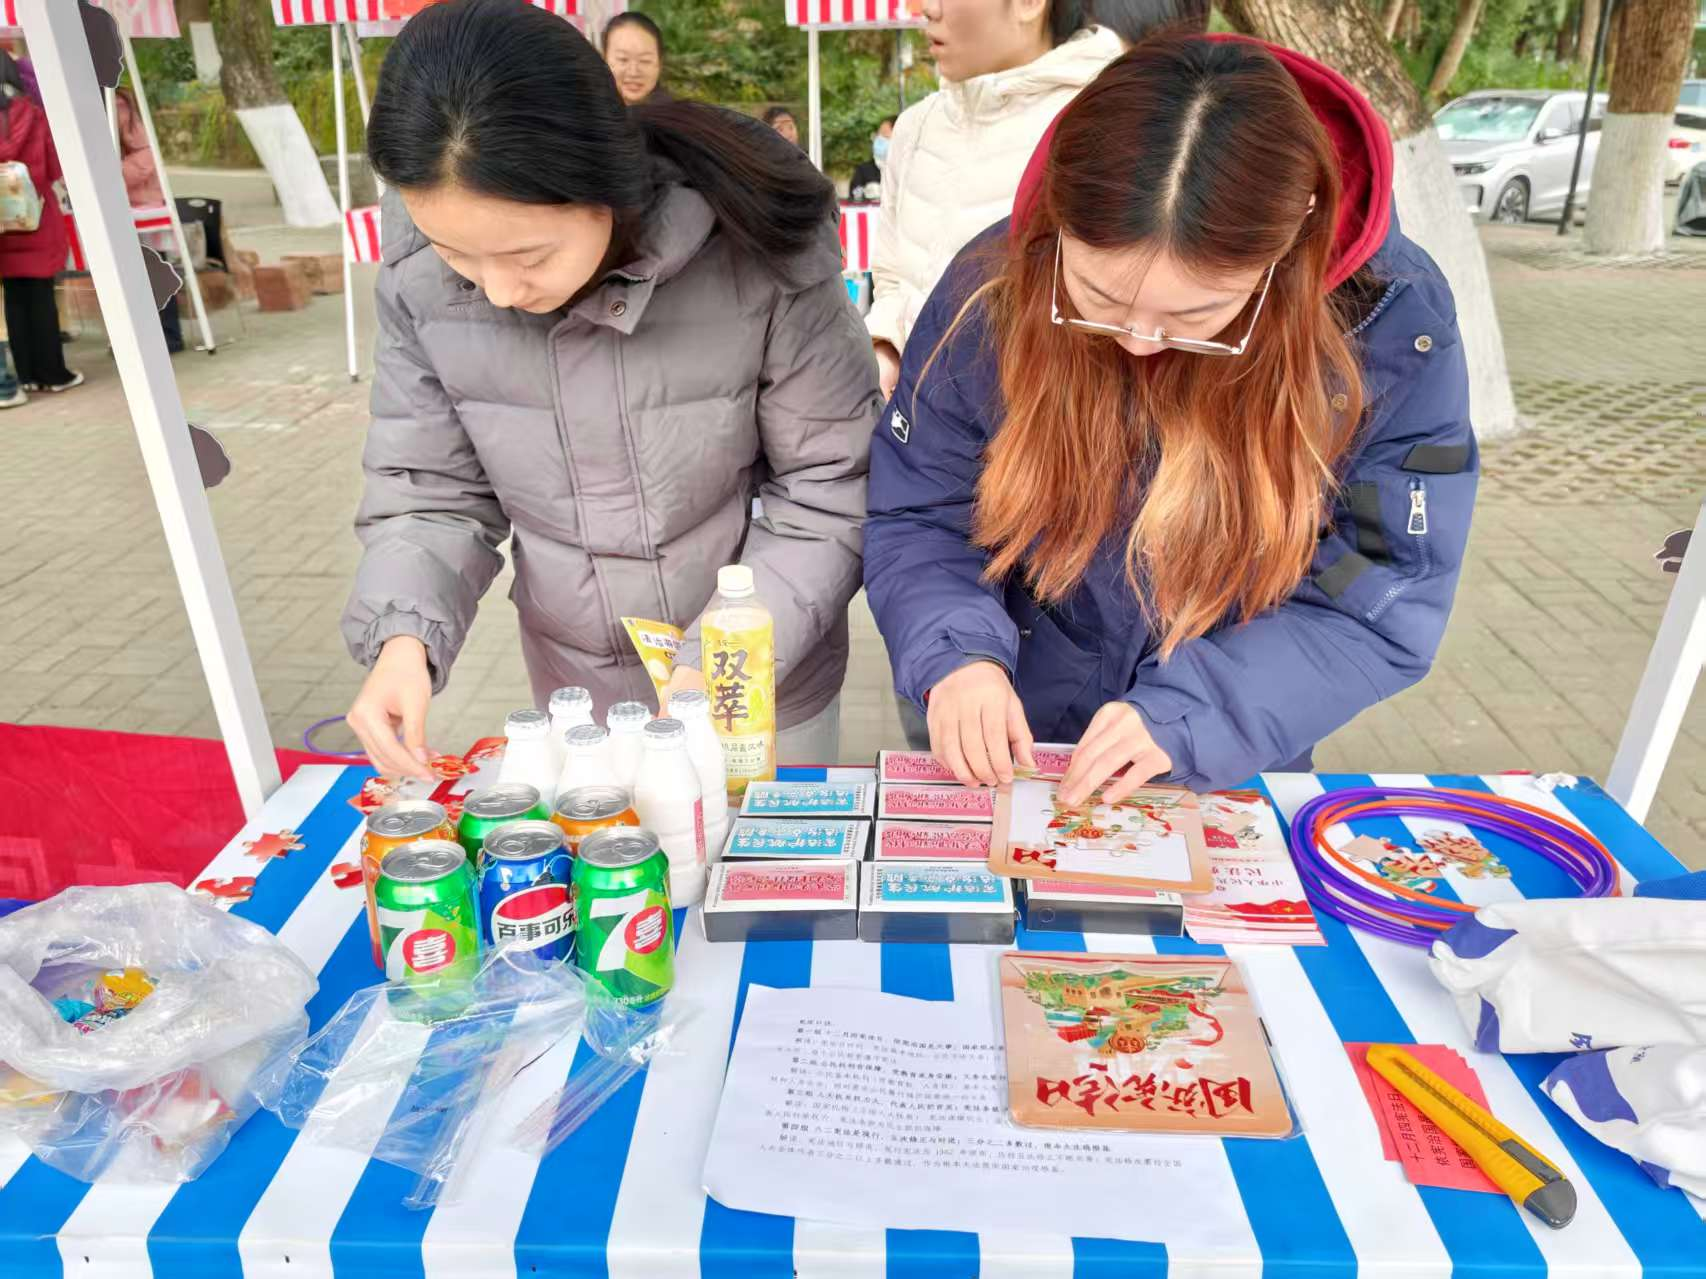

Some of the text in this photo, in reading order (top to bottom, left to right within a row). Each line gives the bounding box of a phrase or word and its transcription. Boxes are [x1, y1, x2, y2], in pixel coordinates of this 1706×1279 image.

[711, 649, 752, 732] 双萃
[497, 907, 576, 941] 百事可乐
